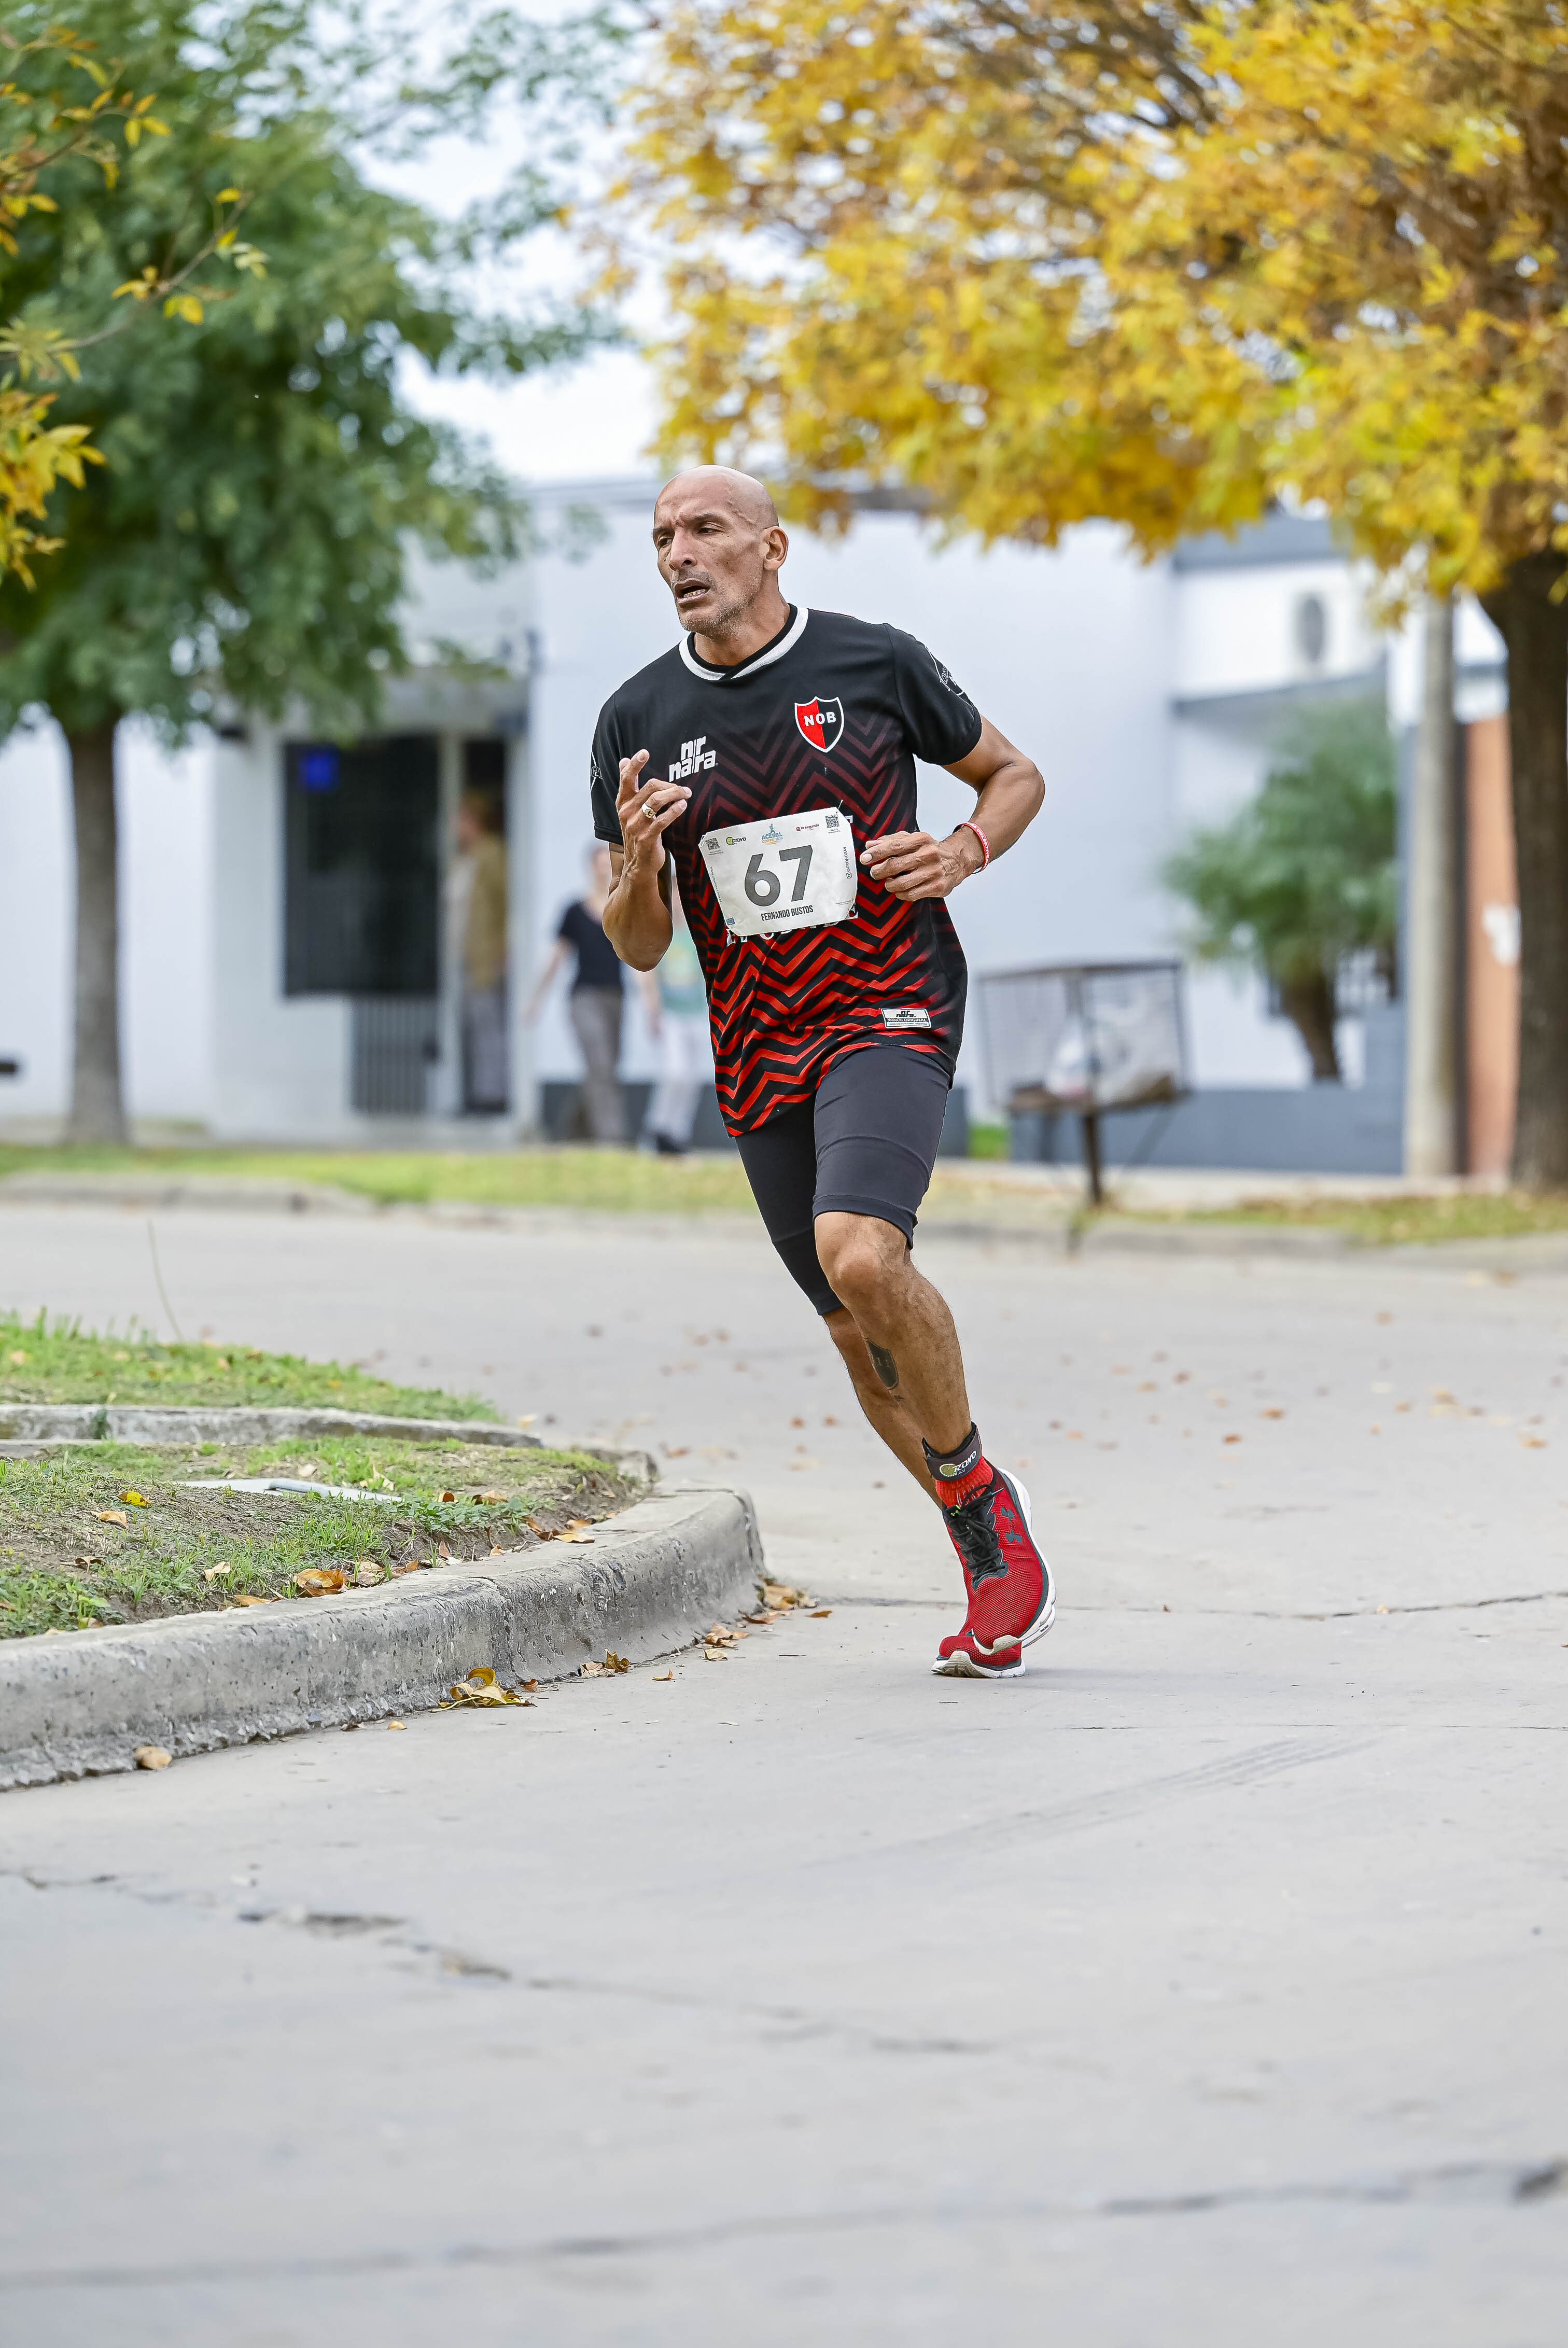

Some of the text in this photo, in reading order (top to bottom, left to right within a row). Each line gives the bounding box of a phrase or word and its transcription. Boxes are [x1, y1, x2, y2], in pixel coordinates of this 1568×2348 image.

[804, 711, 836, 726] NOB
[669, 750, 716, 782] nara
[744, 845, 813, 907] 67
[761, 905, 814, 921] FERNANDO BUSTOS
